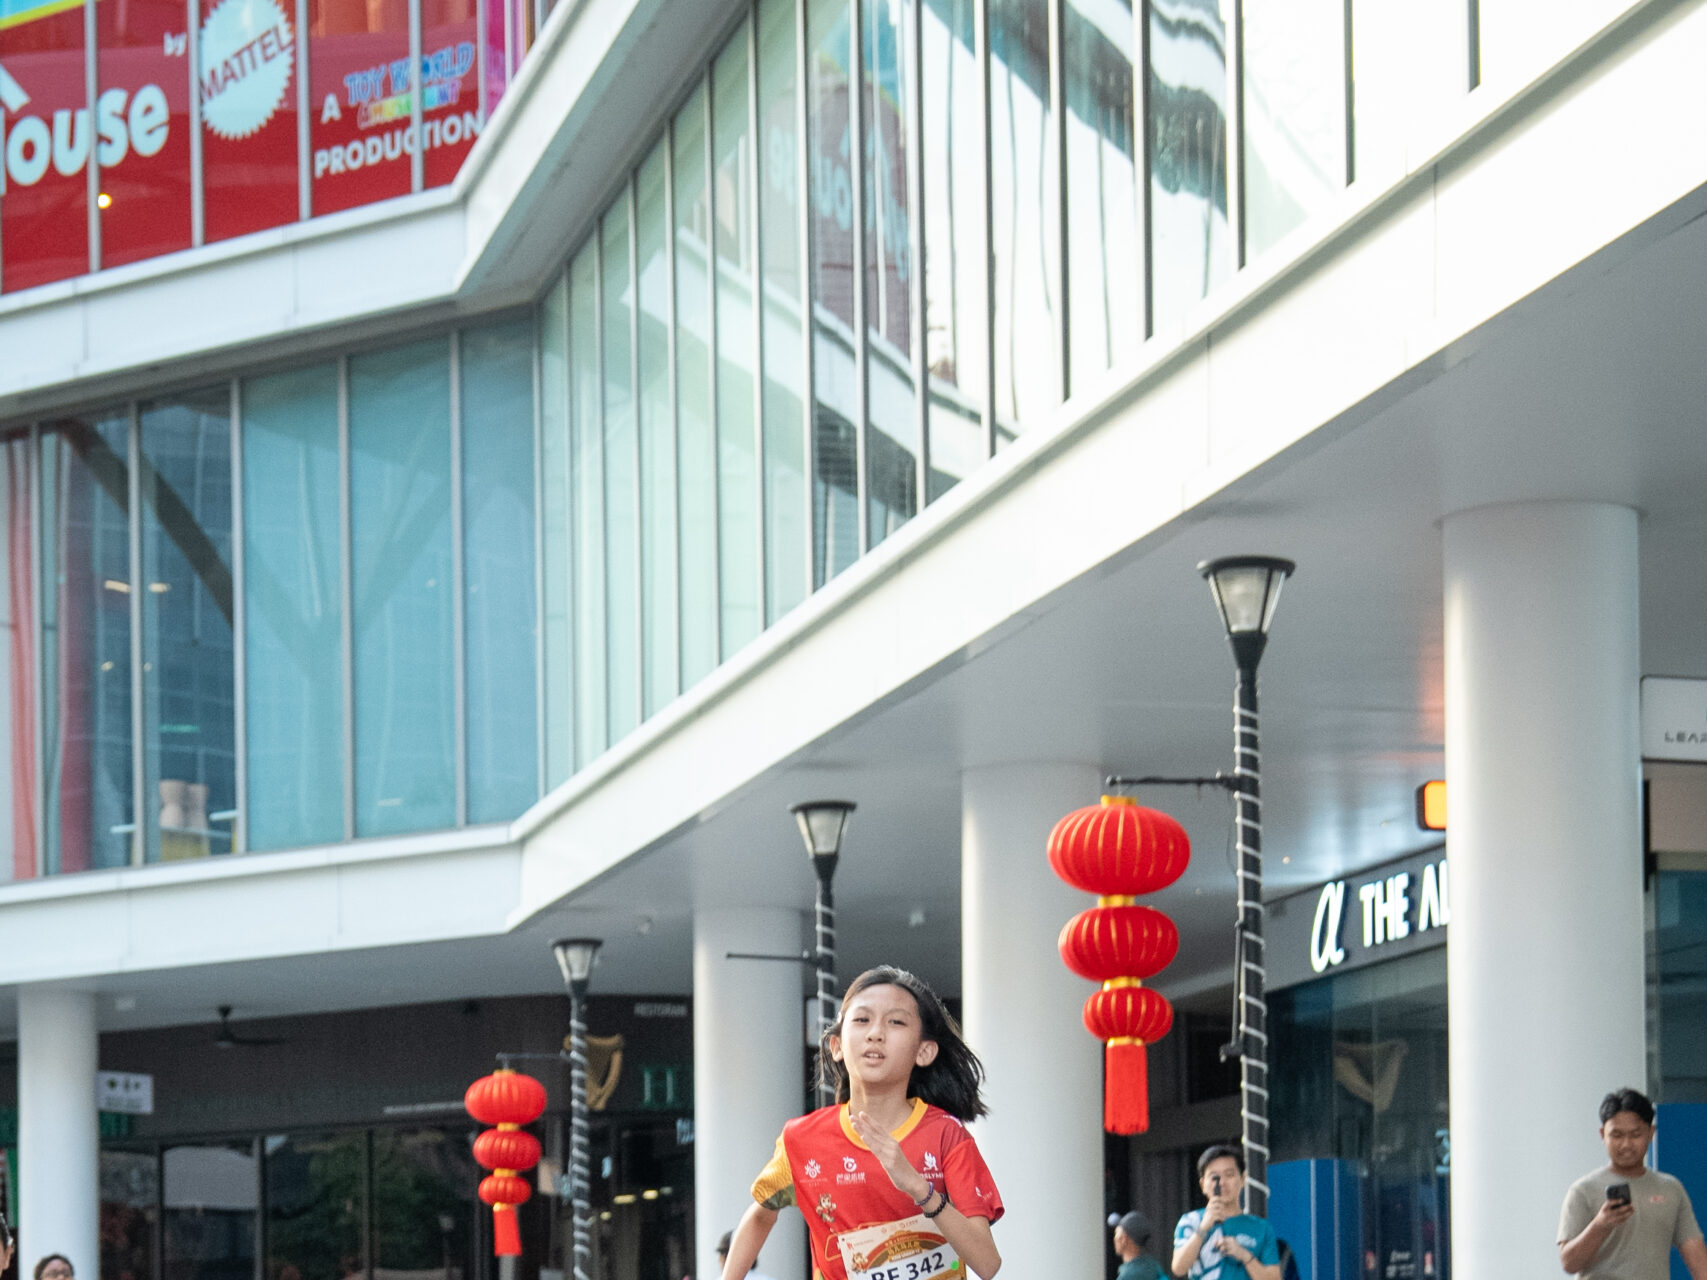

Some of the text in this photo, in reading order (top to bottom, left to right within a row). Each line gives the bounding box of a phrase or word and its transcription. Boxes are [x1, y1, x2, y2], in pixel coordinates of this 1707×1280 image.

[163, 25, 294, 103] by MATTEL
[344, 42, 475, 107] TOY WORLD
[0, 83, 170, 196] ouse
[320, 93, 342, 124] A
[314, 110, 482, 179] PRODUCTION
[1359, 872, 1410, 948] THE
[906, 1252, 945, 1280] 342
